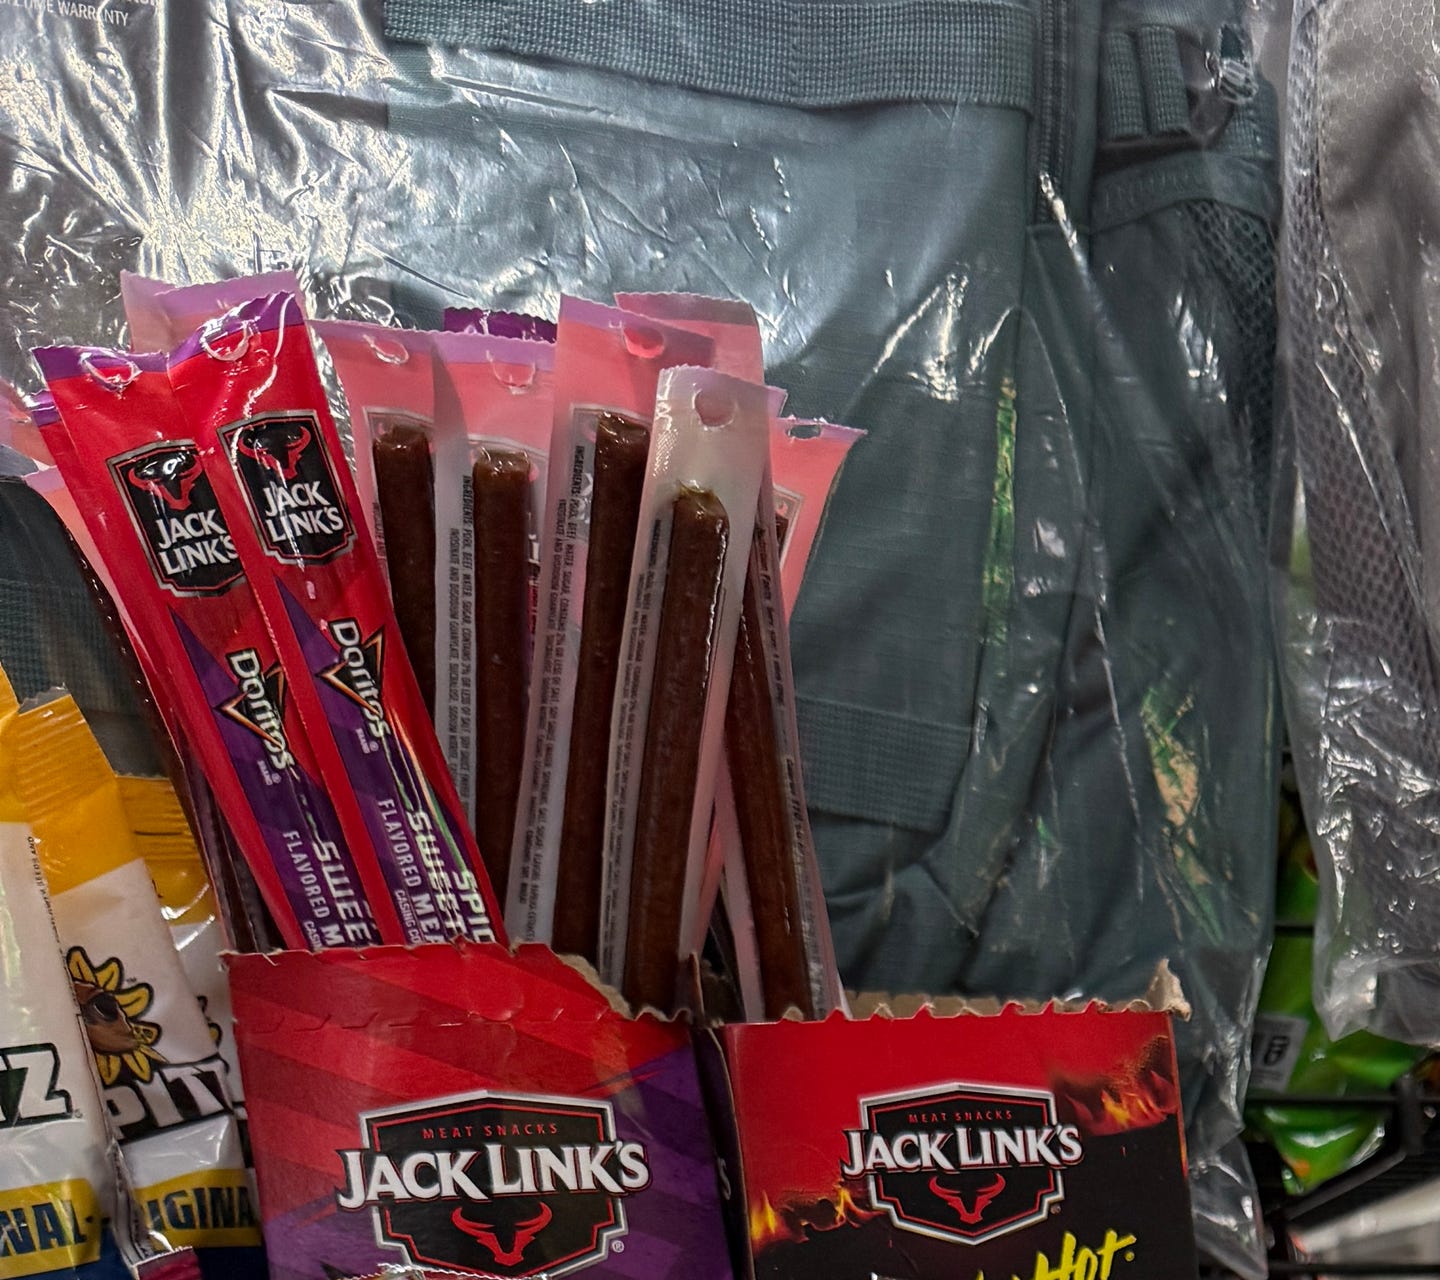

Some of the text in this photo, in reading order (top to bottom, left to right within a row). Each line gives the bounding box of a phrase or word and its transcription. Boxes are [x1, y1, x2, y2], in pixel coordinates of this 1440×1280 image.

[262, 480, 330, 518] JACK
[155, 508, 228, 550] JACK
[265, 506, 345, 544] LINK'S
[158, 535, 240, 576] LINK'S
[328, 619, 392, 738] Doritos
[226, 648, 295, 770] Doritos
[378, 798, 422, 887] FLAVORED
[283, 830, 331, 919] FLAVORED
[421, 1122, 559, 1140] MEAT SNACKS
[908, 1109, 1013, 1124] MEAT SNACKS
[842, 1124, 1083, 1176] JACK LINK'S
[335, 1139, 651, 1210] JACK LINK'S
